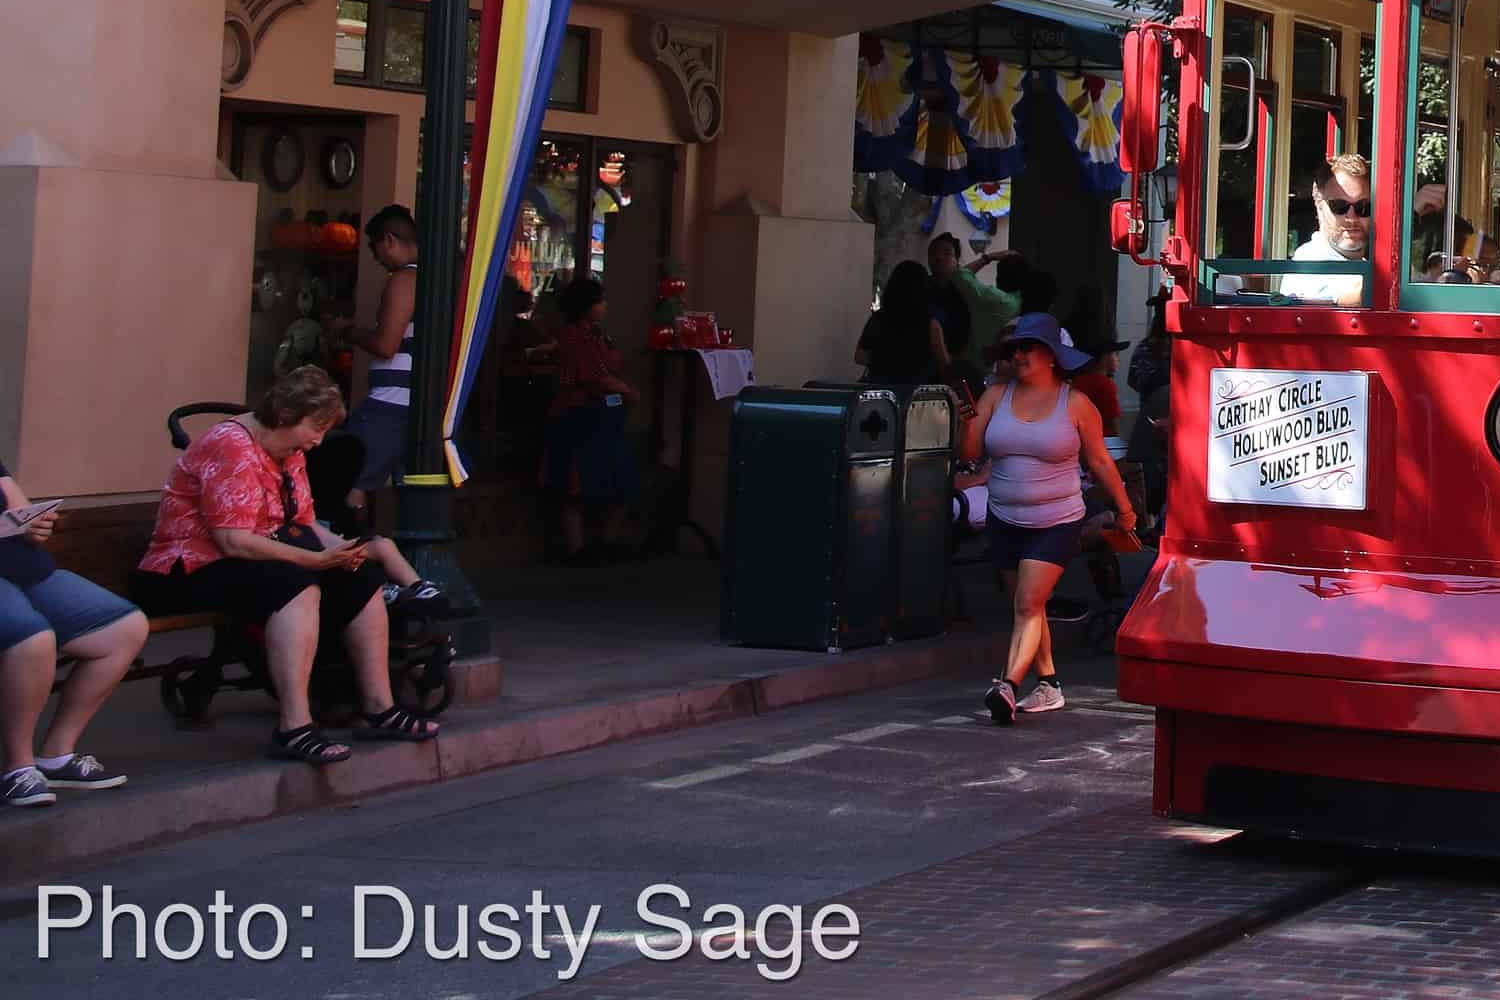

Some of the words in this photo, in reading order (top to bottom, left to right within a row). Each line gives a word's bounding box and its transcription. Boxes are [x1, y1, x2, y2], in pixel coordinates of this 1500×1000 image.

[1217, 395, 1273, 430] CARTHAY
[1278, 380, 1322, 412] CIRCLE
[1233, 417, 1312, 459] HOLLYWOOD
[1316, 406, 1352, 434] BLVD.
[1259, 452, 1310, 486] SUNSET
[1316, 441, 1352, 470] BLVD.
